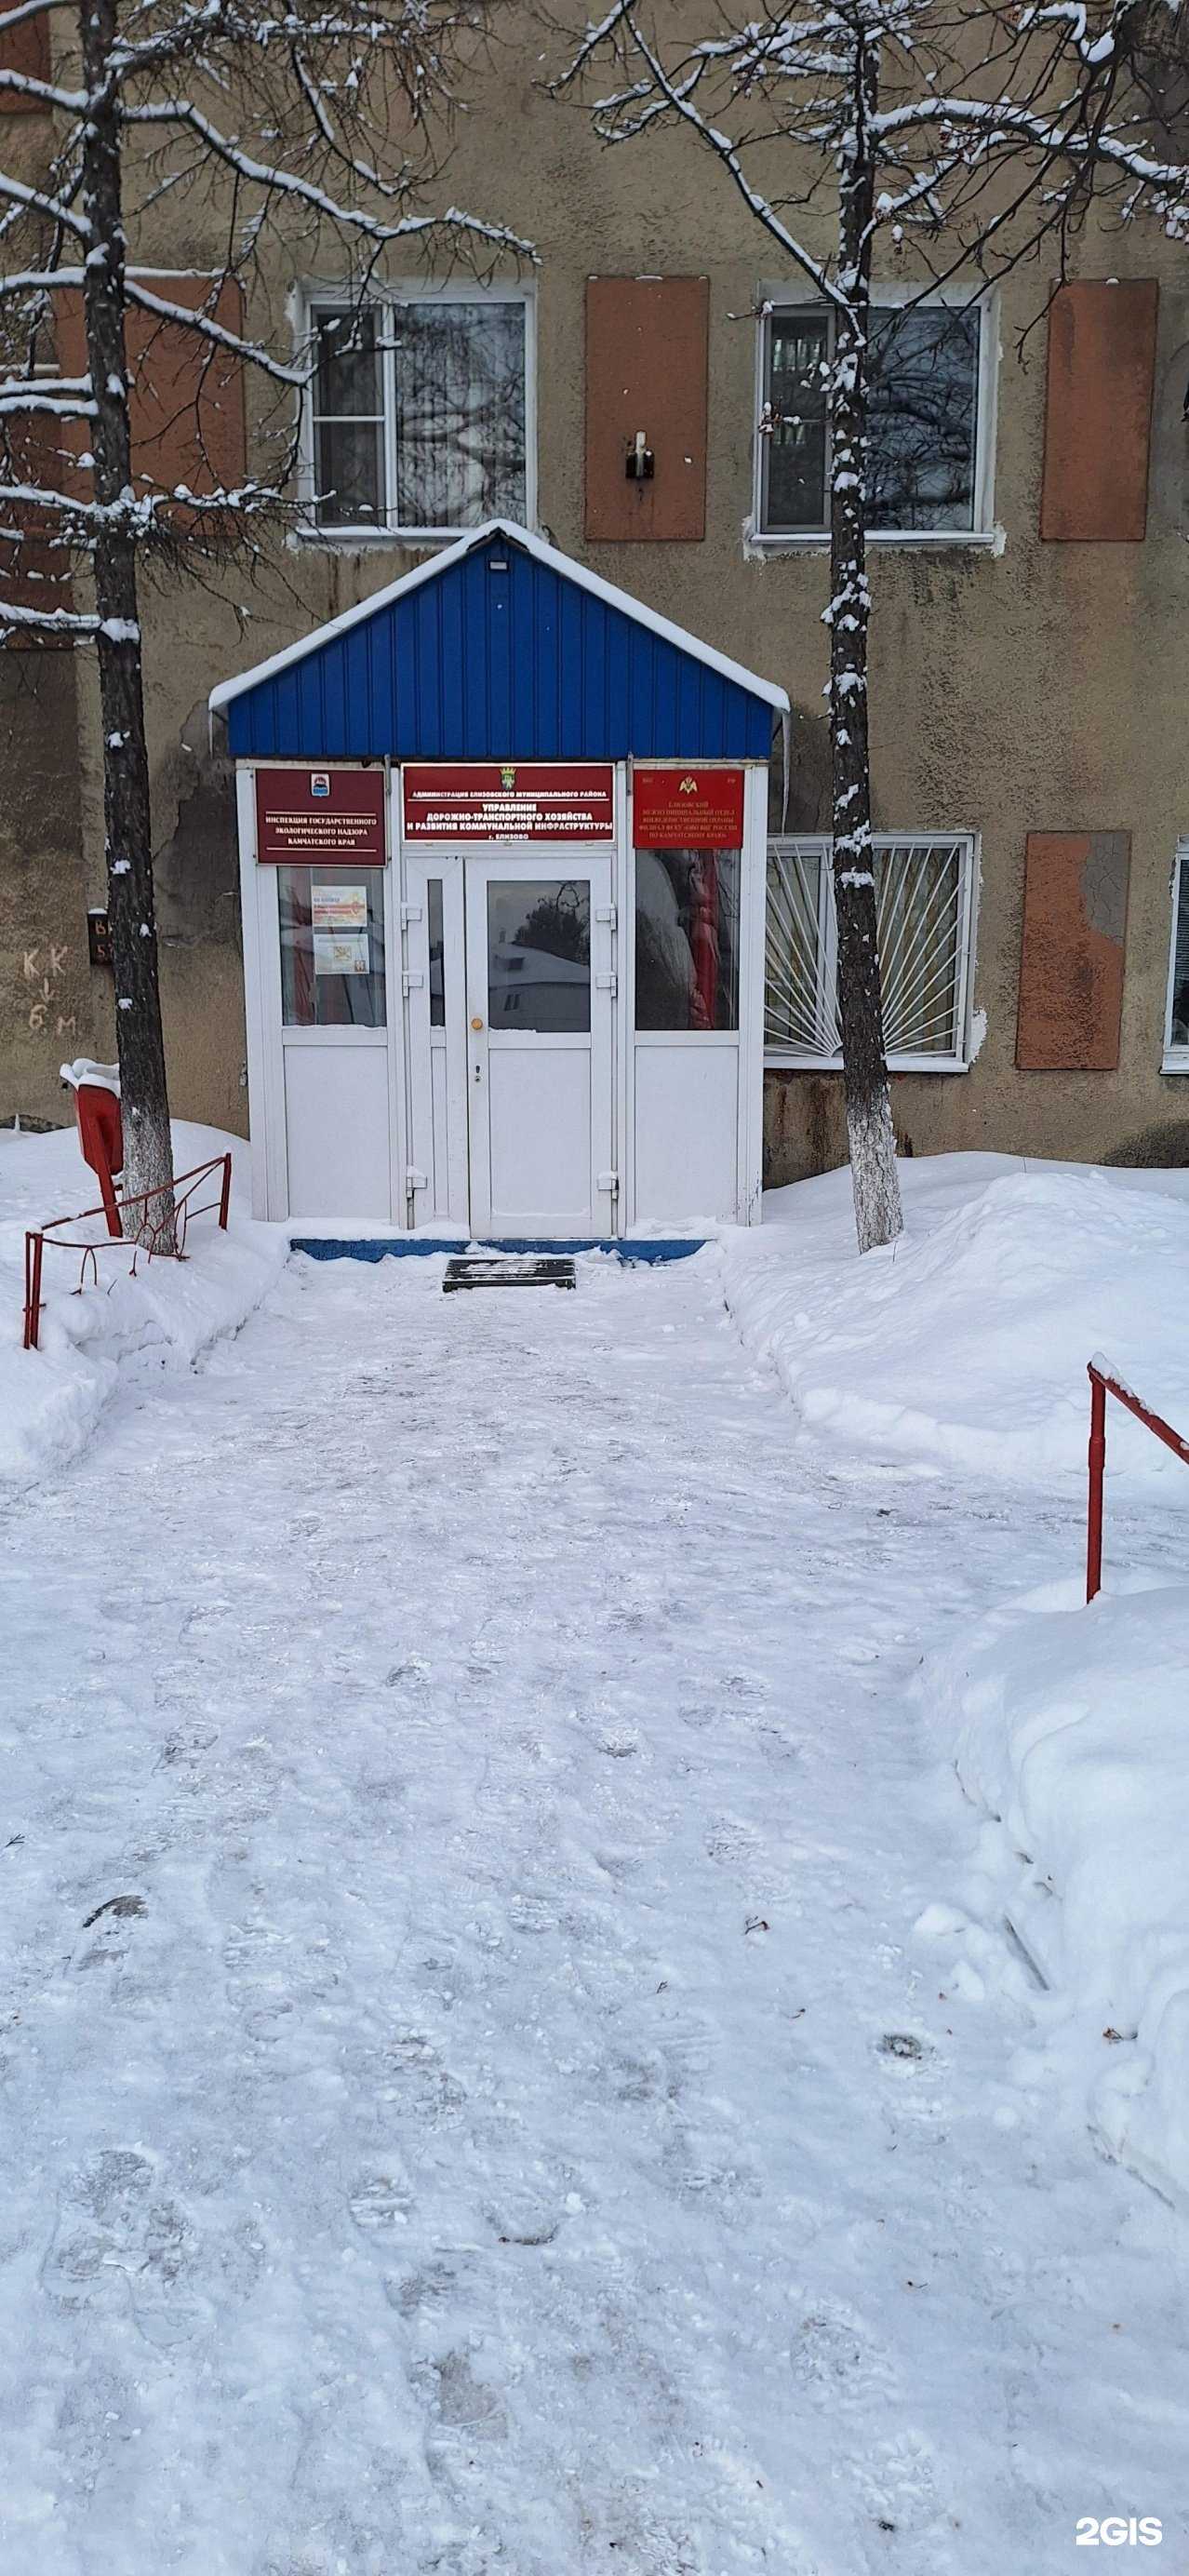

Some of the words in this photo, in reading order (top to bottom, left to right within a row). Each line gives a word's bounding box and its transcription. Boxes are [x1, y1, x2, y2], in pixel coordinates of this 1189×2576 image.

[482, 803, 537, 812] УПРАВЛЕНИЕ
[265, 816, 307, 825] ИНСПЕКЦИЯ
[309, 817, 377, 825] ГОСУДАРСТВЕННОГО
[426, 812, 543, 822] ДОРОЖНО-ТРАНСПОРТНОГО
[544, 812, 593, 821] ХОЗЯЙСТВА
[460, 822, 532, 830] КОММУНАЛЬНОЙ
